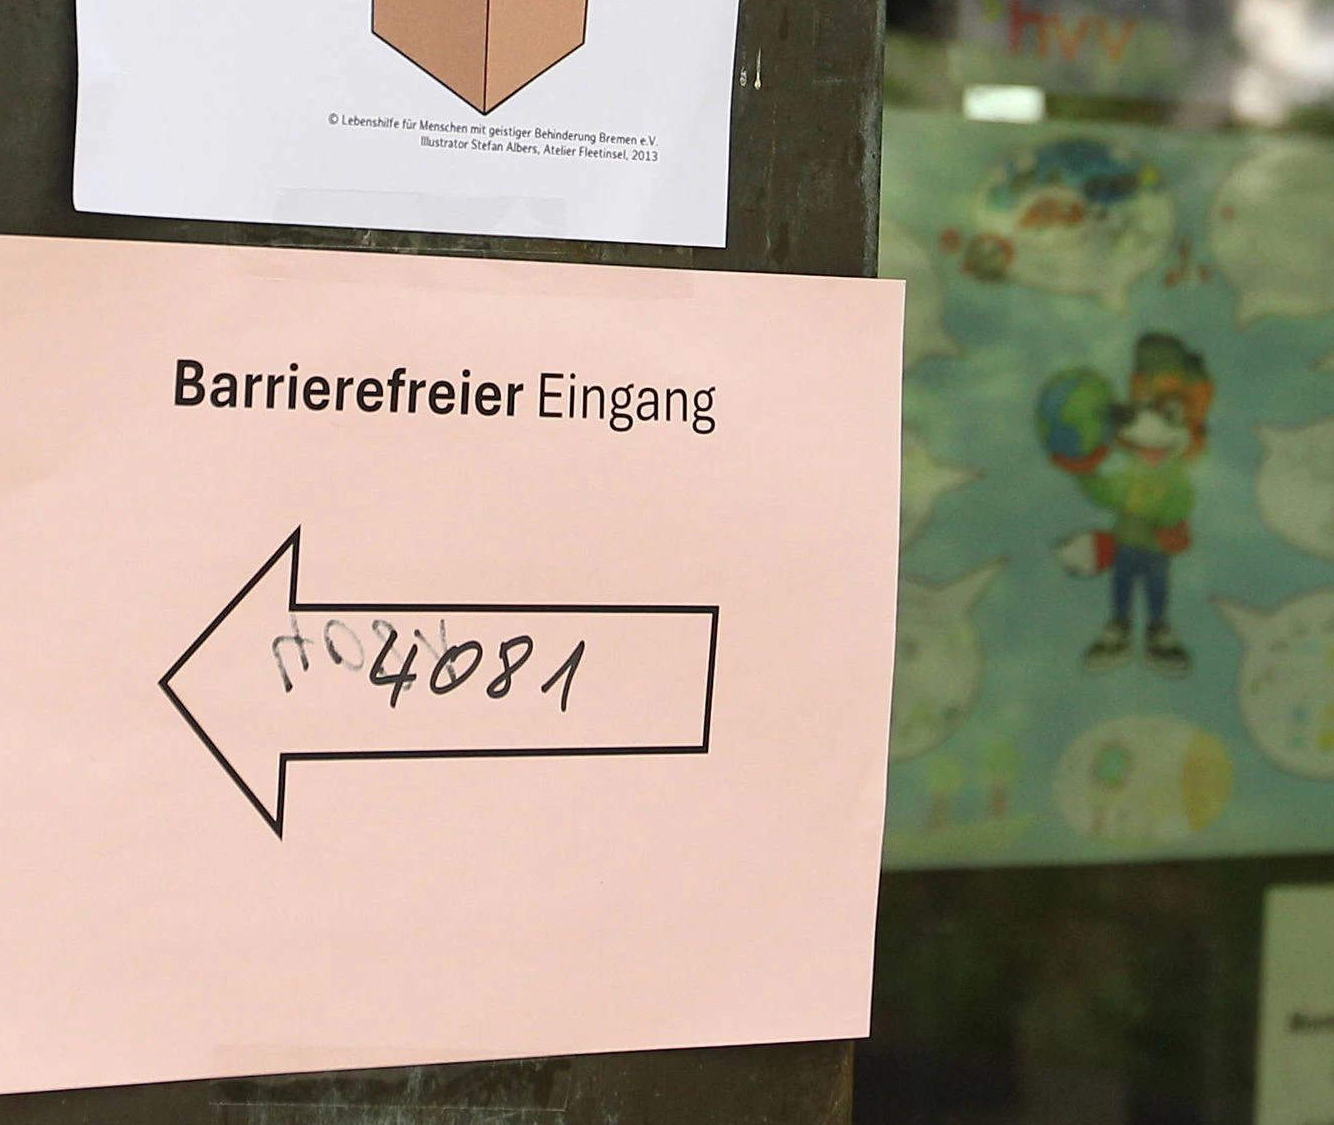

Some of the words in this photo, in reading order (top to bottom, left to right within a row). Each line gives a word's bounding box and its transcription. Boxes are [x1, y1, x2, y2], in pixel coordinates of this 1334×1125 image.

[341, 115, 400, 129] Lebenshilfe
[402, 118, 417, 130] für
[419, 120, 469, 134] Menschen
[470, 123, 486, 135] mit
[489, 126, 532, 139] geistiger
[535, 127, 597, 144] Behinderung
[599, 131, 637, 146] Bremen
[639, 135, 659, 147] e.V.
[421, 136, 468, 149] Illustrator
[471, 139, 503, 152] Stefan
[505, 141, 540, 155] Albers,
[543, 144, 576, 156] Atelier
[579, 146, 629, 161] Fleetinsel,
[631, 149, 659, 162] 2013
[173, 359, 524, 417] Barrierefreier
[538, 371, 717, 435] Eingang
[370, 629, 585, 712] 4081
